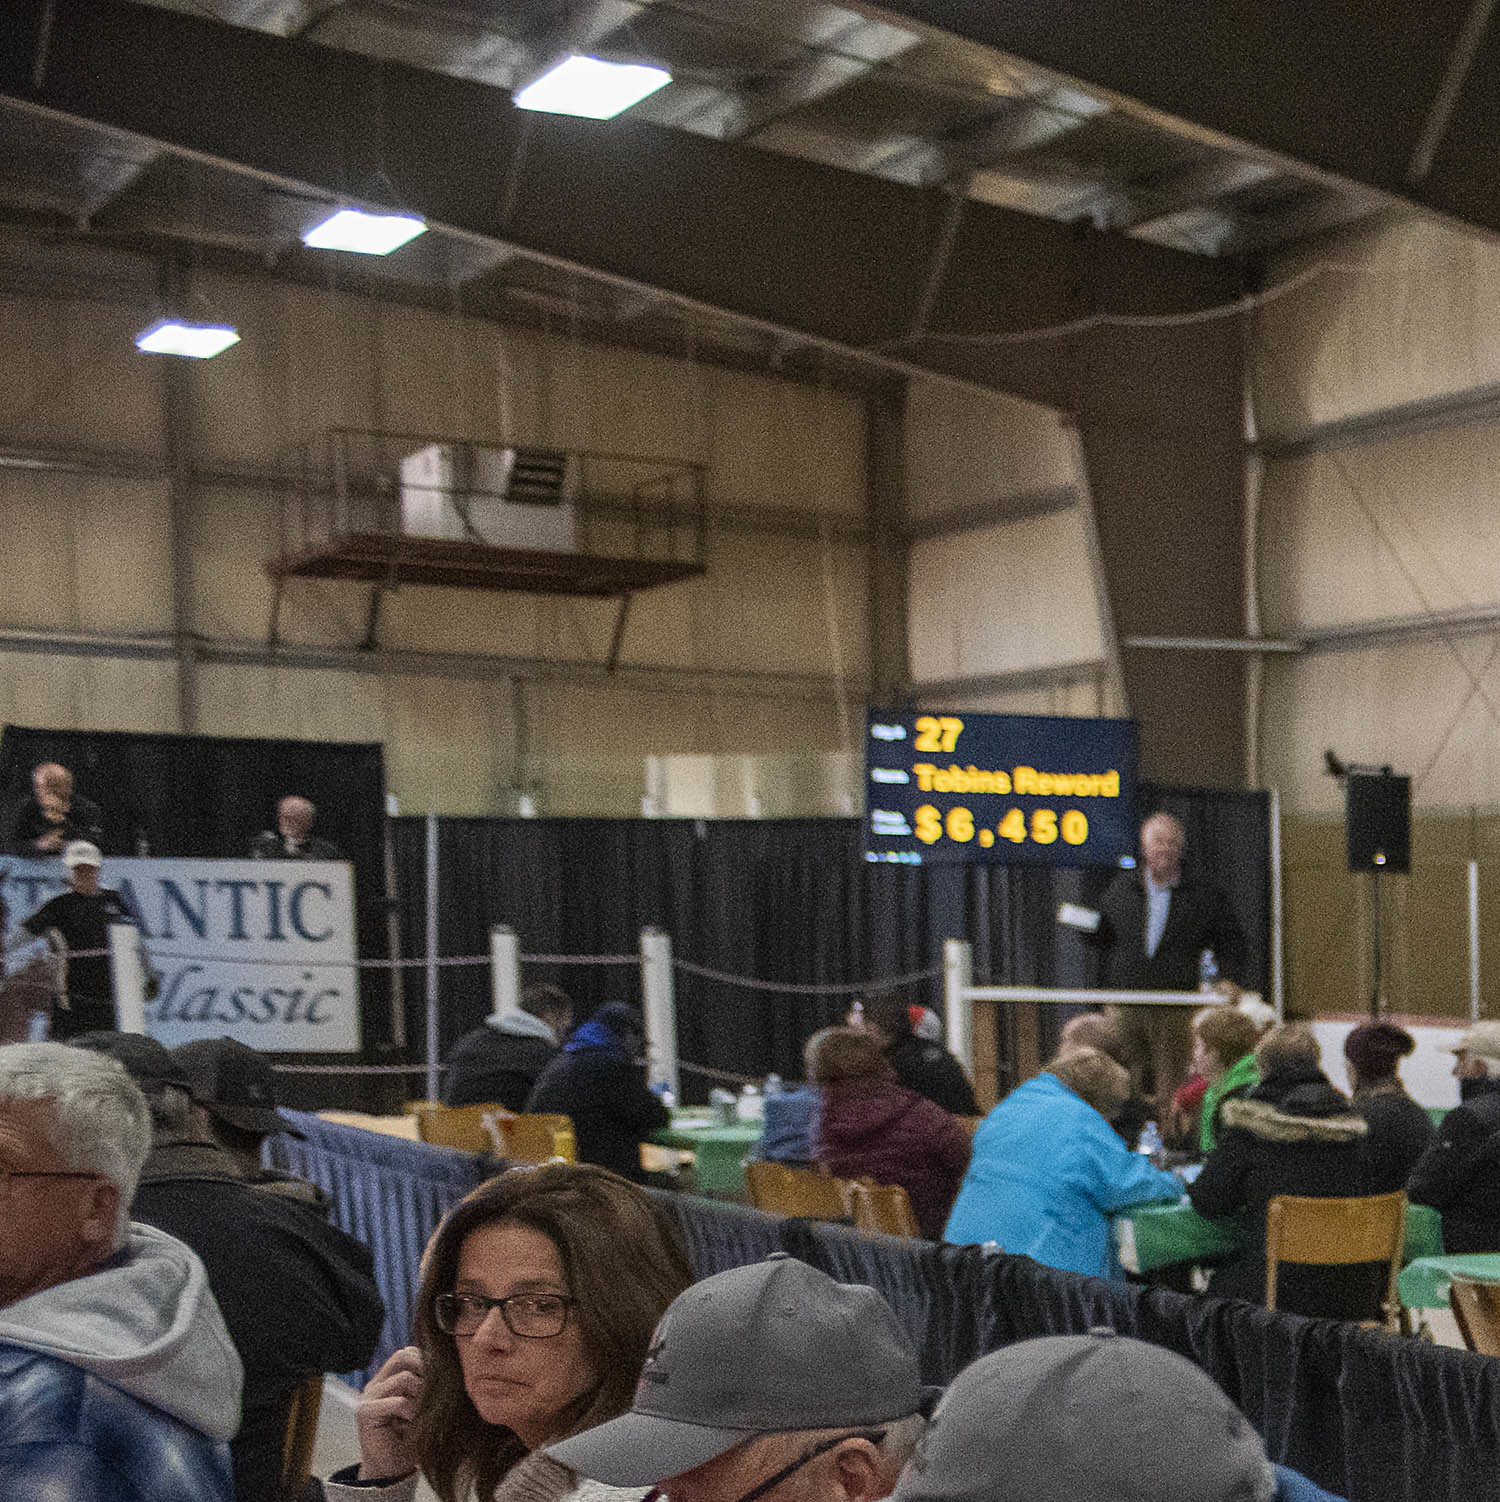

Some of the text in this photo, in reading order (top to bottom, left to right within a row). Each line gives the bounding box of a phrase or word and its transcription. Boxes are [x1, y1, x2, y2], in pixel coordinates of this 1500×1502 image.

[914, 715, 965, 753] 27
[914, 804, 1089, 849] $6,450
[152, 965, 341, 1025] lassic
